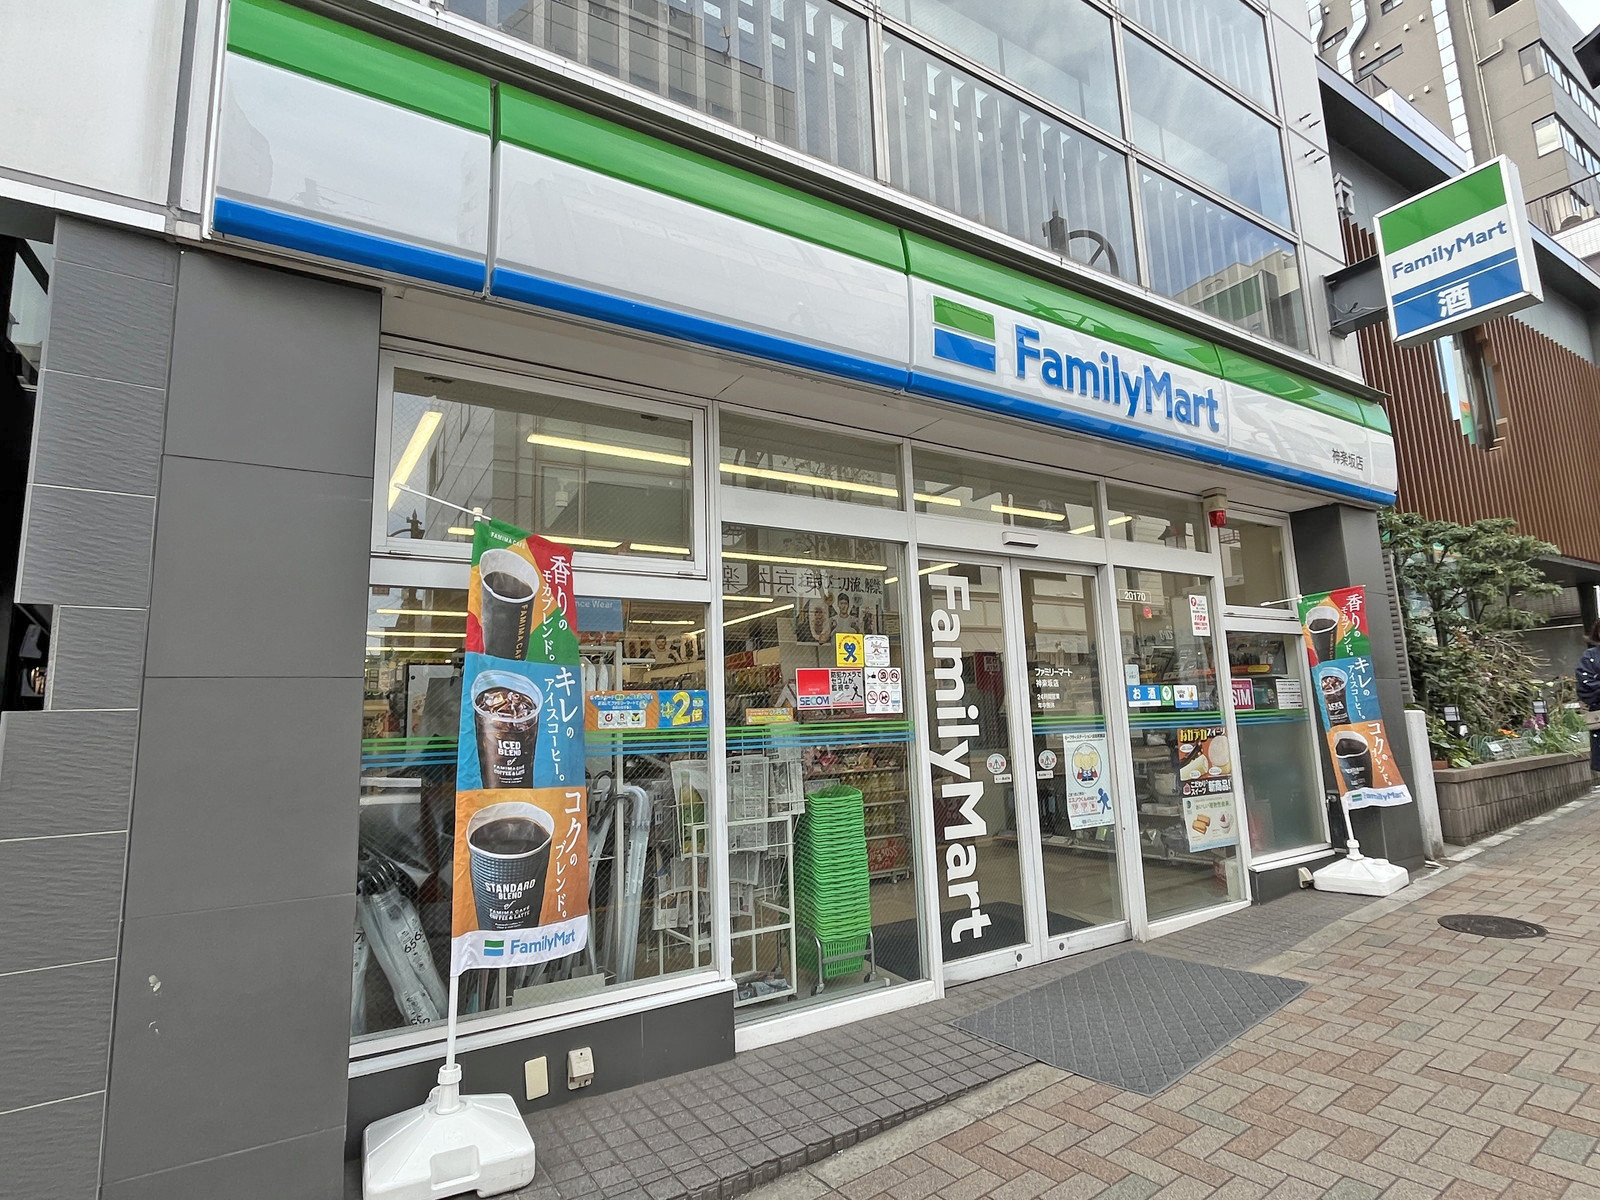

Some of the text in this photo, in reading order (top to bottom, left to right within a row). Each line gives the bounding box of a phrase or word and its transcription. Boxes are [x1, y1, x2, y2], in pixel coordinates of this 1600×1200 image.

[1391, 220, 1508, 280] FamilyMart
[1437, 282, 1472, 318] 酒
[1014, 323, 1220, 433] FamilyMart
[1331, 448, 1364, 472] 神楽坂店
[490, 531, 512, 544] FAMIMA
[549, 555, 571, 631] 香りの
[592, 600, 613, 609] Wear
[1124, 590, 1146, 601] 20170
[542, 569, 555, 661] モカブレンド。
[1346, 593, 1363, 638] 香りの
[1034, 667, 1073, 677] ファミリーマート
[1355, 657, 1372, 696] キレの
[555, 666, 578, 739] キレの
[800, 696, 829, 705] SECOM
[1132, 687, 1156, 700] お酒
[498, 740, 521, 750] ICED
[544, 678, 565, 782] アイスコーヒー。
[1367, 722, 1388, 760] コクの
[498, 748, 521, 757] BLEND
[928, 574, 992, 944] FamilyMart
[1362, 791, 1406, 801] FamilyMart
[565, 791, 582, 867] コクの
[484, 878, 536, 893] STANDARD
[555, 840, 568, 918] ブレンド。
[498, 891, 523, 900] BLEND
[510, 929, 576, 955] FamilyMart
